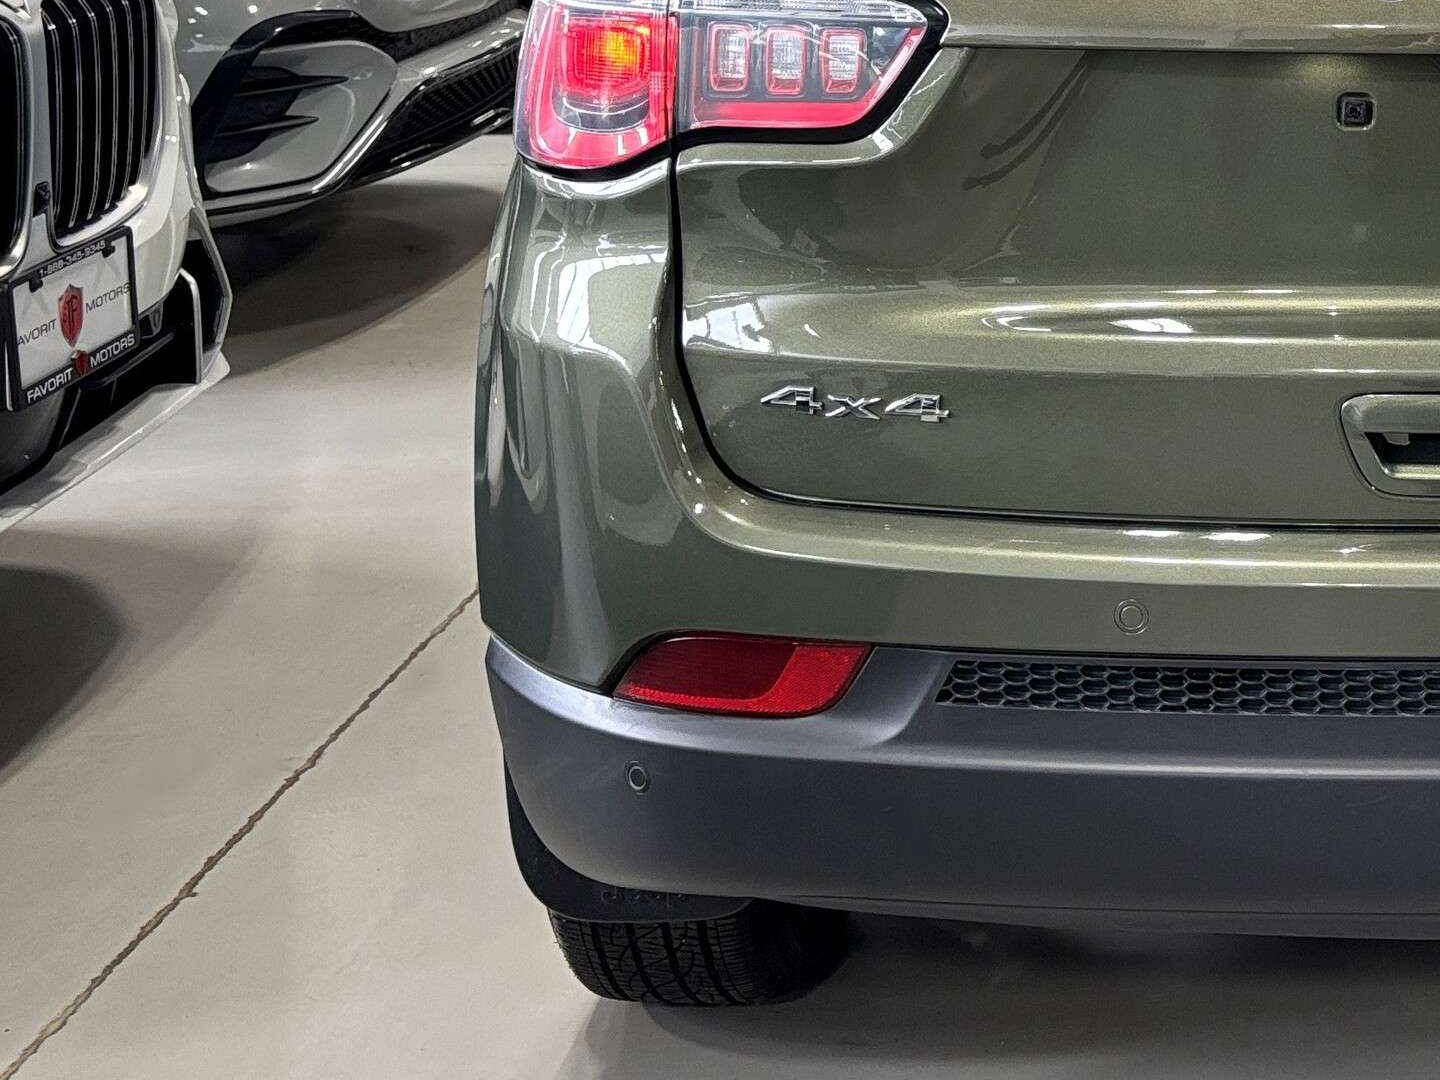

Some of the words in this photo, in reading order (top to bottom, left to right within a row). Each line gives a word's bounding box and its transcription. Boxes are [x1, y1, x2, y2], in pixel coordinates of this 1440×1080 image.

[85, 282, 131, 313] MOTORS
[27, 368, 73, 404] FAVORIT
[90, 334, 135, 368] MOTORS
